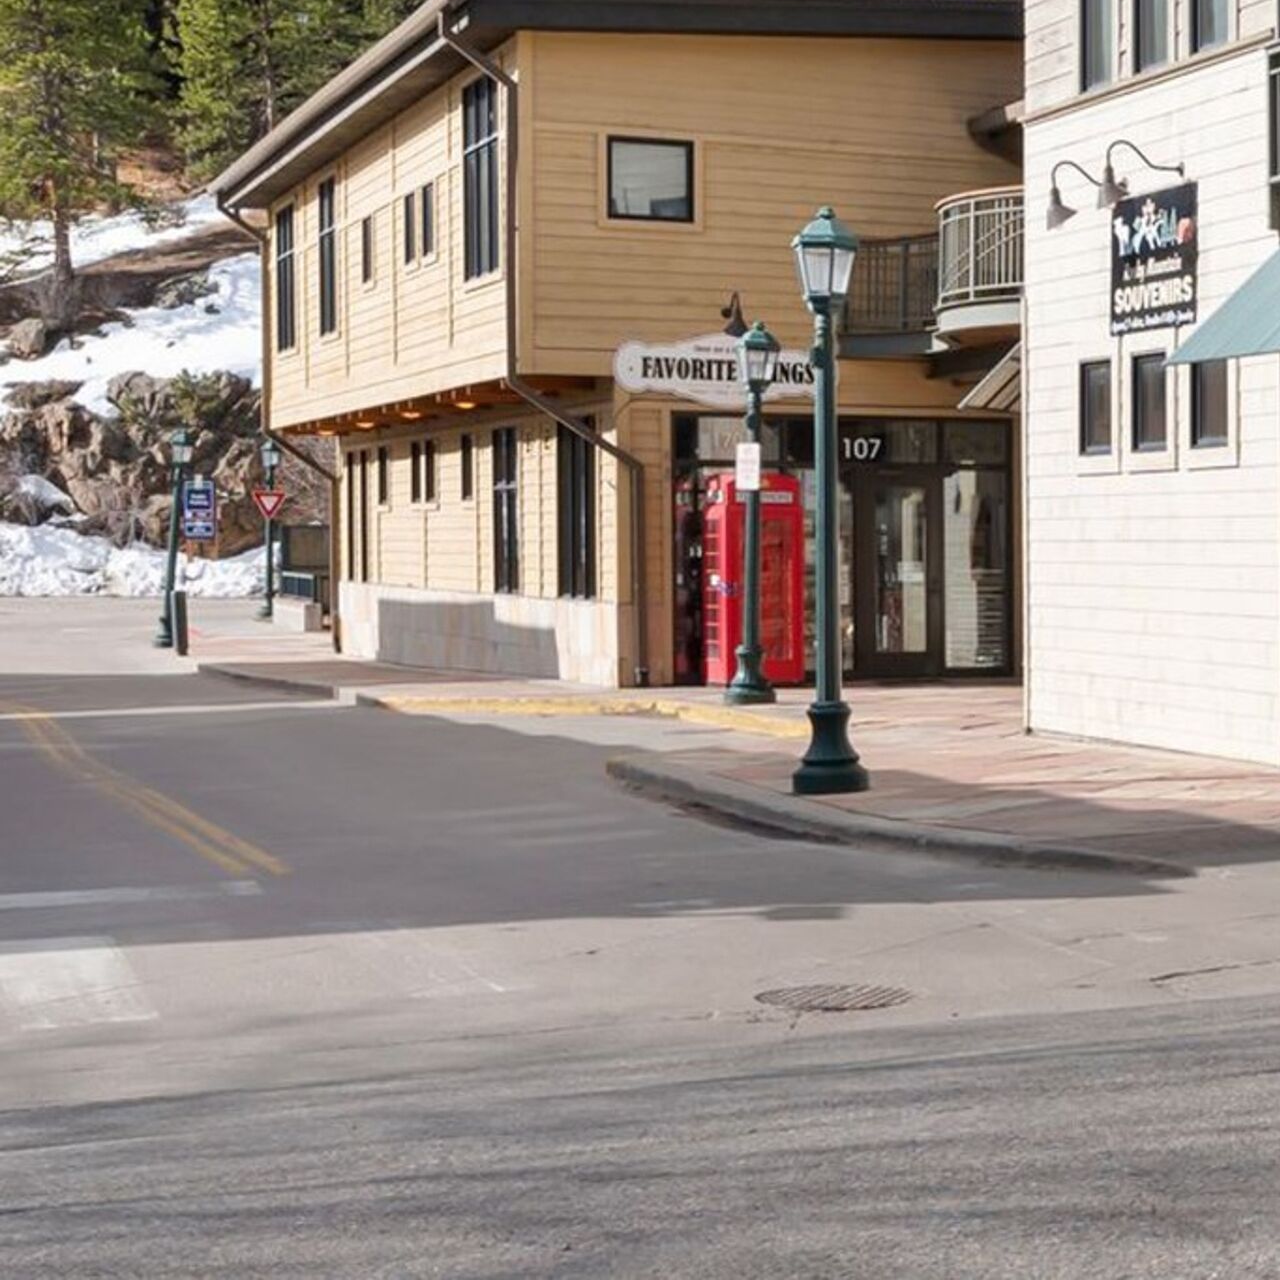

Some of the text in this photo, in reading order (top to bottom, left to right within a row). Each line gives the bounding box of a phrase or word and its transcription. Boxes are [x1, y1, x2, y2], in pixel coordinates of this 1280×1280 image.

[1114, 274, 1193, 314] SOUVENIRS
[641, 356, 737, 381] FAVORITE
[842, 437, 881, 459] 107
